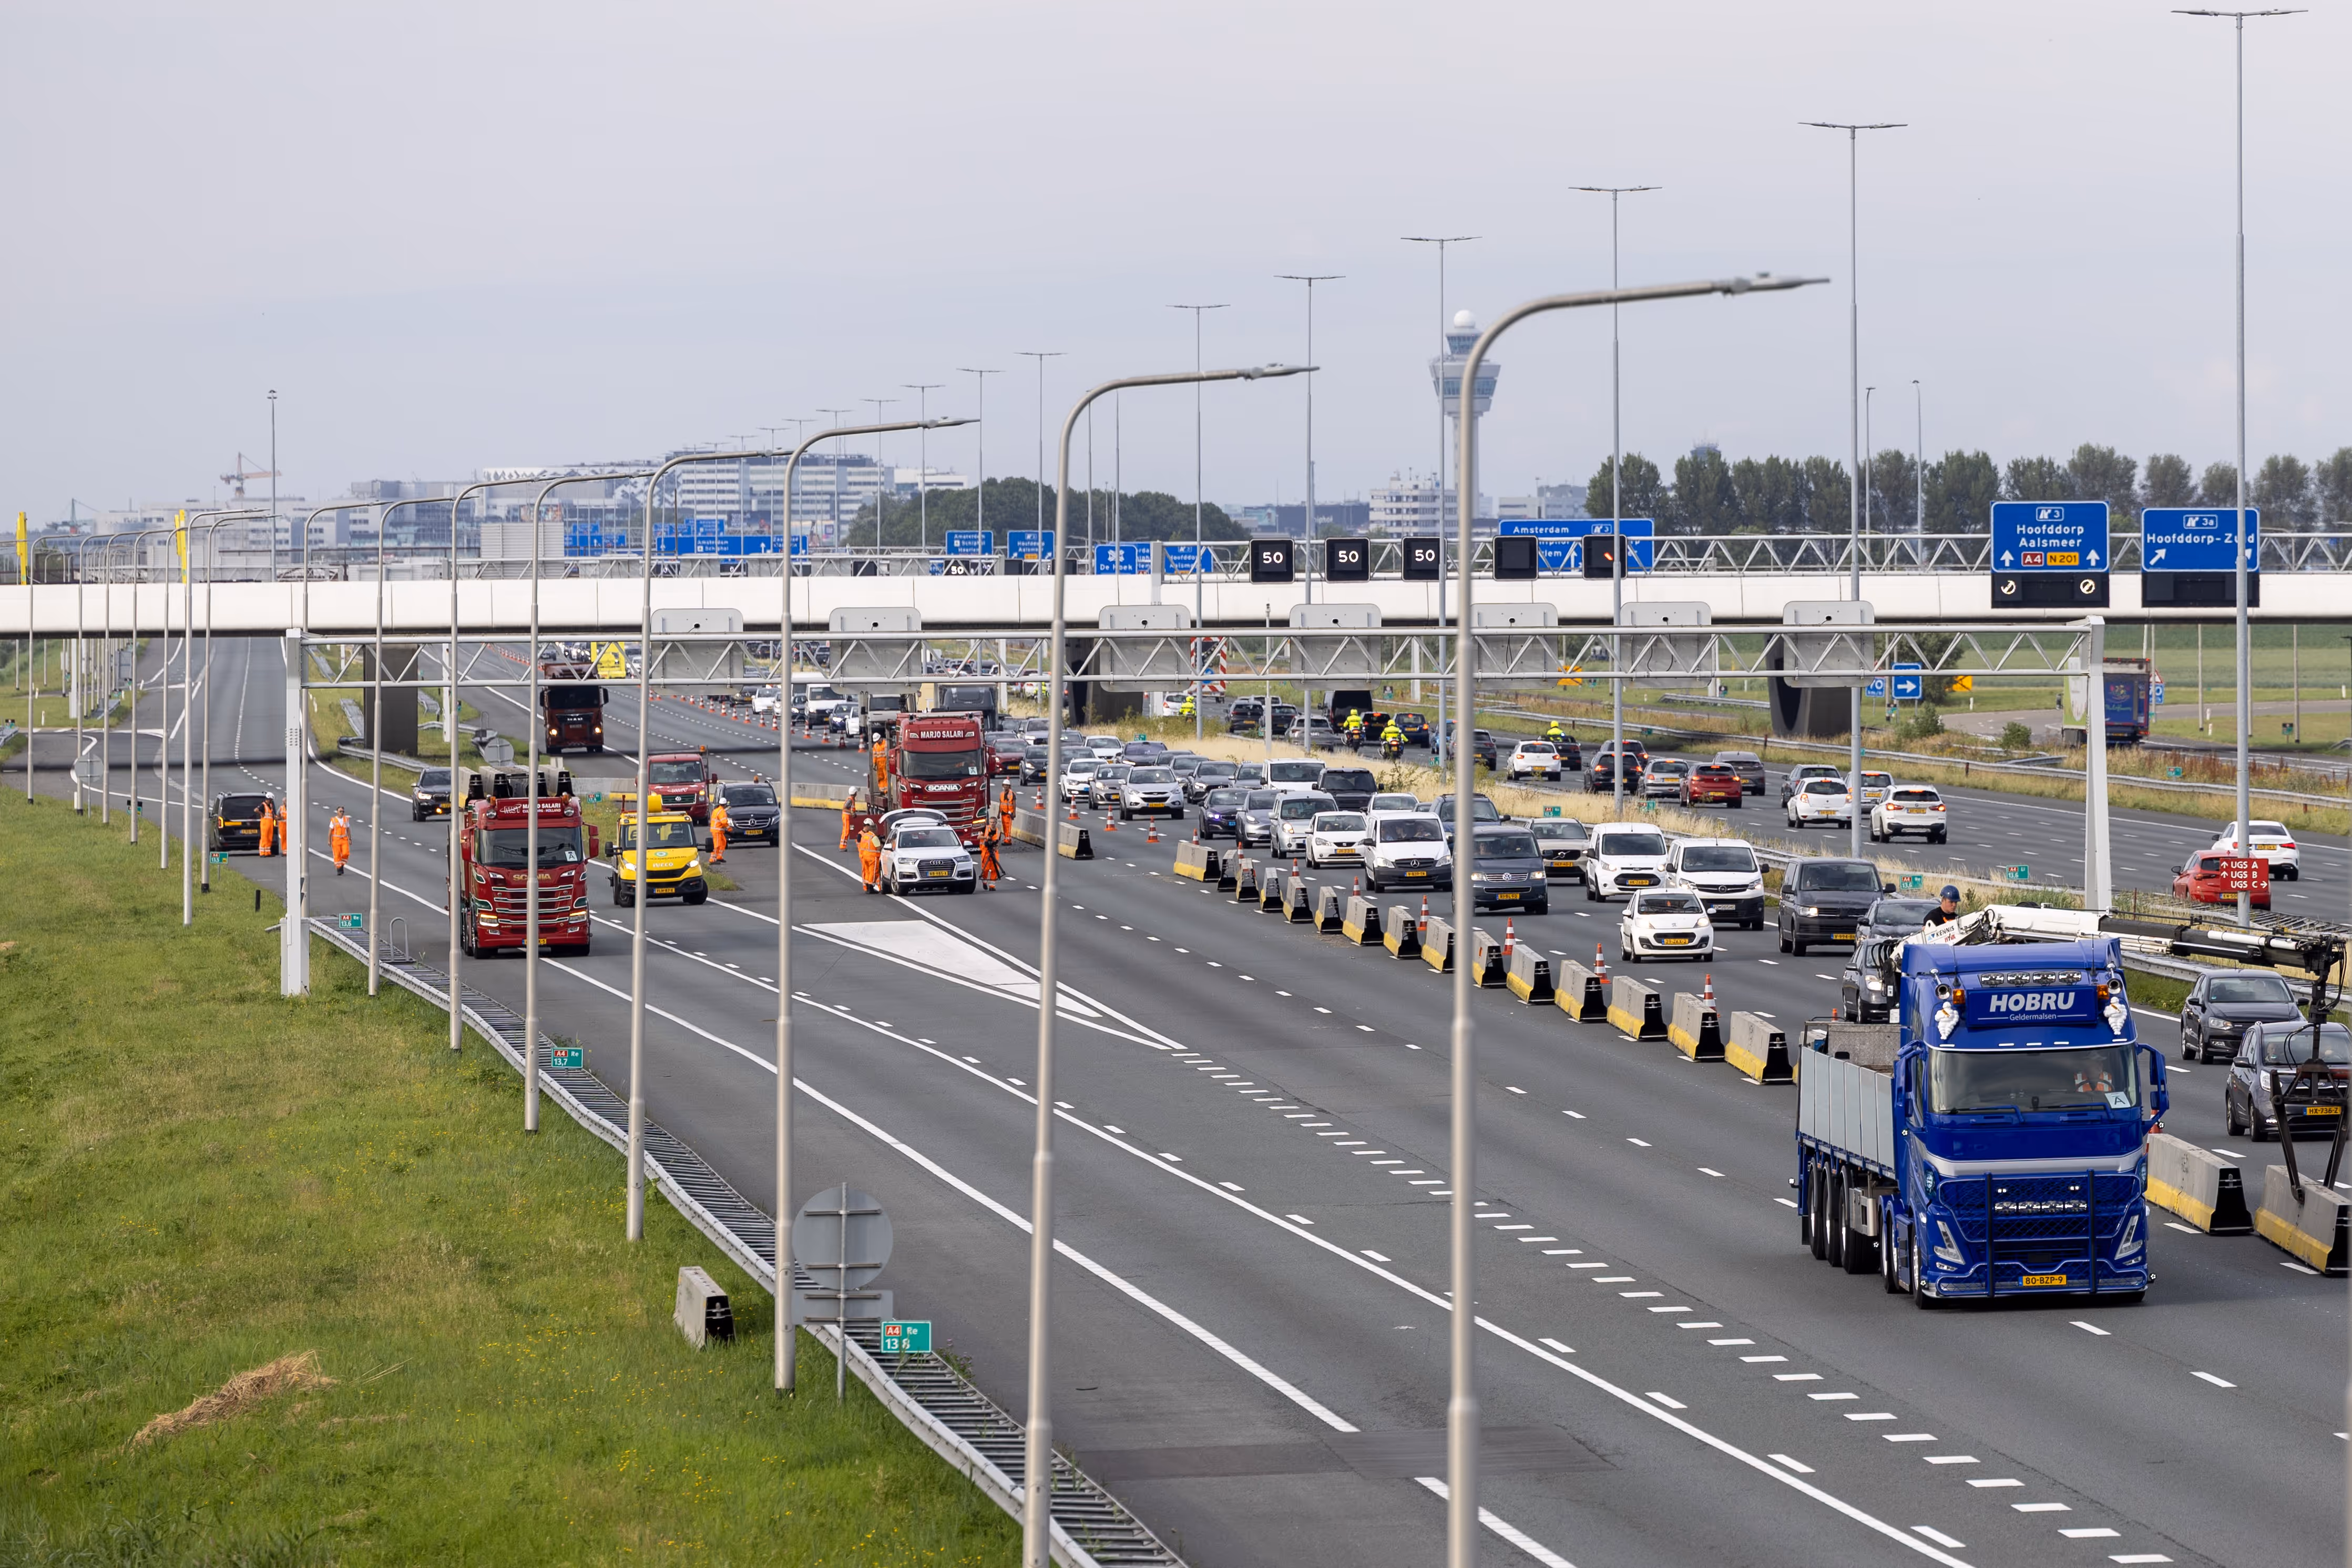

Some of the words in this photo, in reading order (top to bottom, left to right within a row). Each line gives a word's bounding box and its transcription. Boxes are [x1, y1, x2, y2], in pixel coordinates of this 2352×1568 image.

[2017, 525, 2084, 535] Hoofddorp
[2019, 537, 2082, 547] Aalsmeer
[1263, 551, 1283, 563] 50
[1338, 550, 1359, 563] 50
[1415, 549, 1435, 562] 50
[1936, 926, 1955, 937] KENNIS
[1945, 934, 1956, 942] HYVA
[1989, 992, 2075, 1012] HOBRU
[554, 1058, 568, 1066] 13,7
[2114, 1096, 2125, 1105] A
[887, 1327, 899, 1335] A4
[885, 1338, 910, 1349] 138
